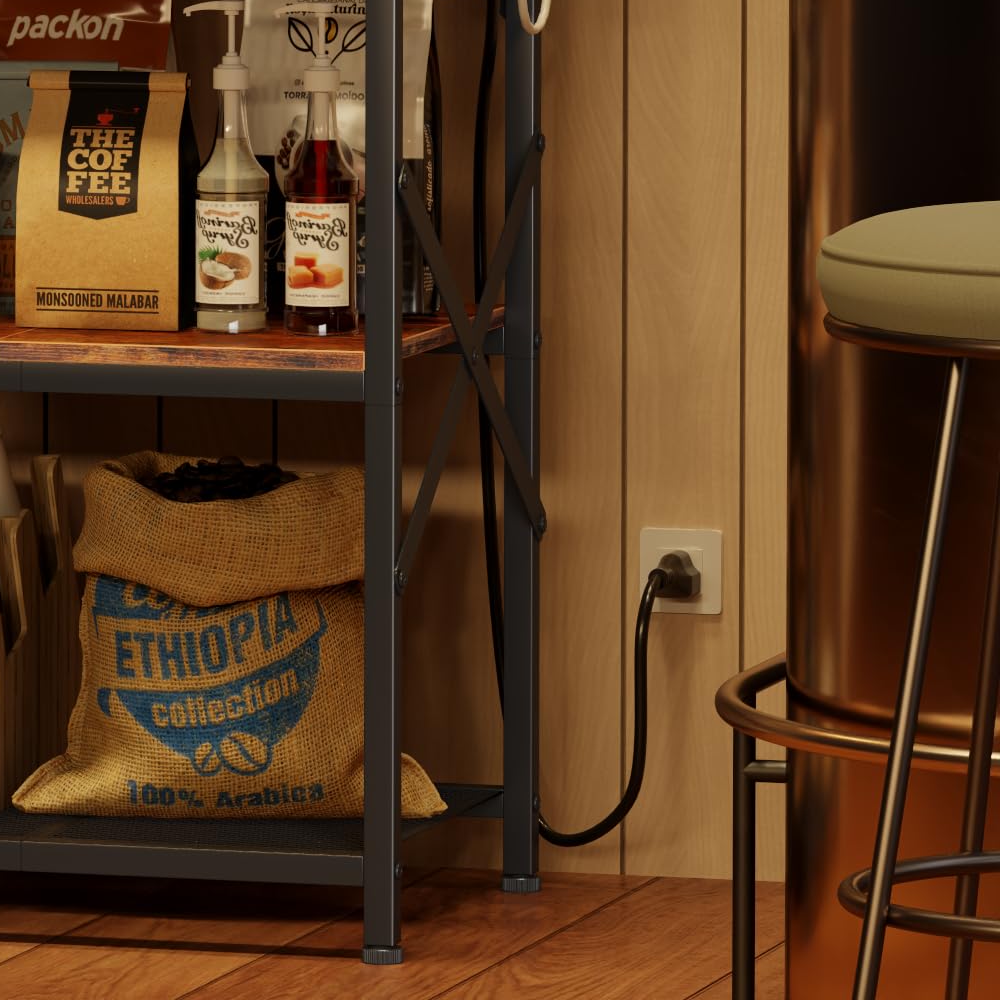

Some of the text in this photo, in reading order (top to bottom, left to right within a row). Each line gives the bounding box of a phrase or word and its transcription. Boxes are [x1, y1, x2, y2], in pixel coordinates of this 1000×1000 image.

[7, 8, 126, 48] packon
[70, 128, 135, 150] THE
[67, 149, 133, 171] COF
[66, 171, 131, 195] FEE
[65, 195, 115, 207] WHOLESALERS
[36, 291, 159, 310] MONSOONED MALABAR
[115, 592, 298, 682] ETHIOPIA
[151, 667, 299, 730] collection
[127, 779, 325, 810] 100% Arabica
